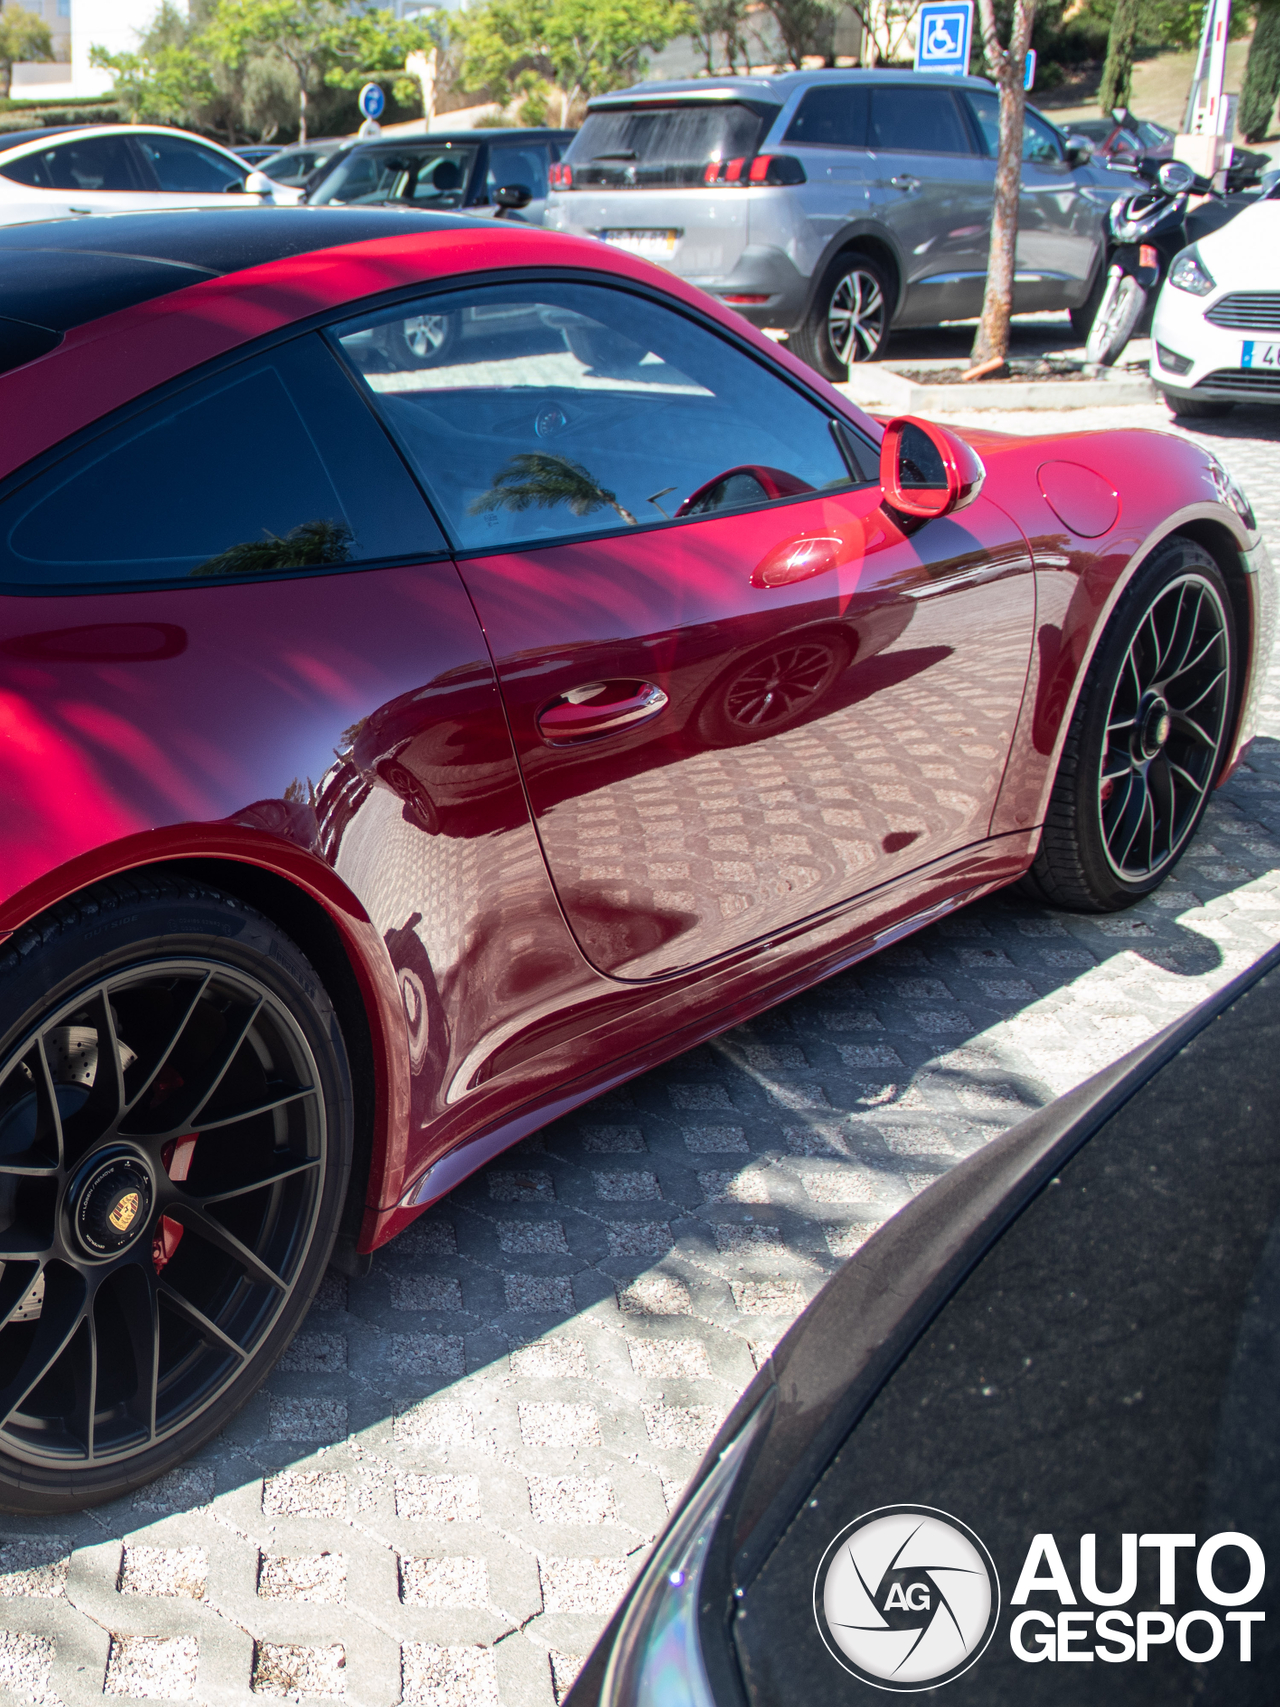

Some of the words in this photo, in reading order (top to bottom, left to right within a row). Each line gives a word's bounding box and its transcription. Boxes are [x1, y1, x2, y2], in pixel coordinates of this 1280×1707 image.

[84, 914, 140, 940] OUTSIDE
[268, 938, 317, 1000] PIRELLI
[94, 1167, 115, 1186] REMOVE
